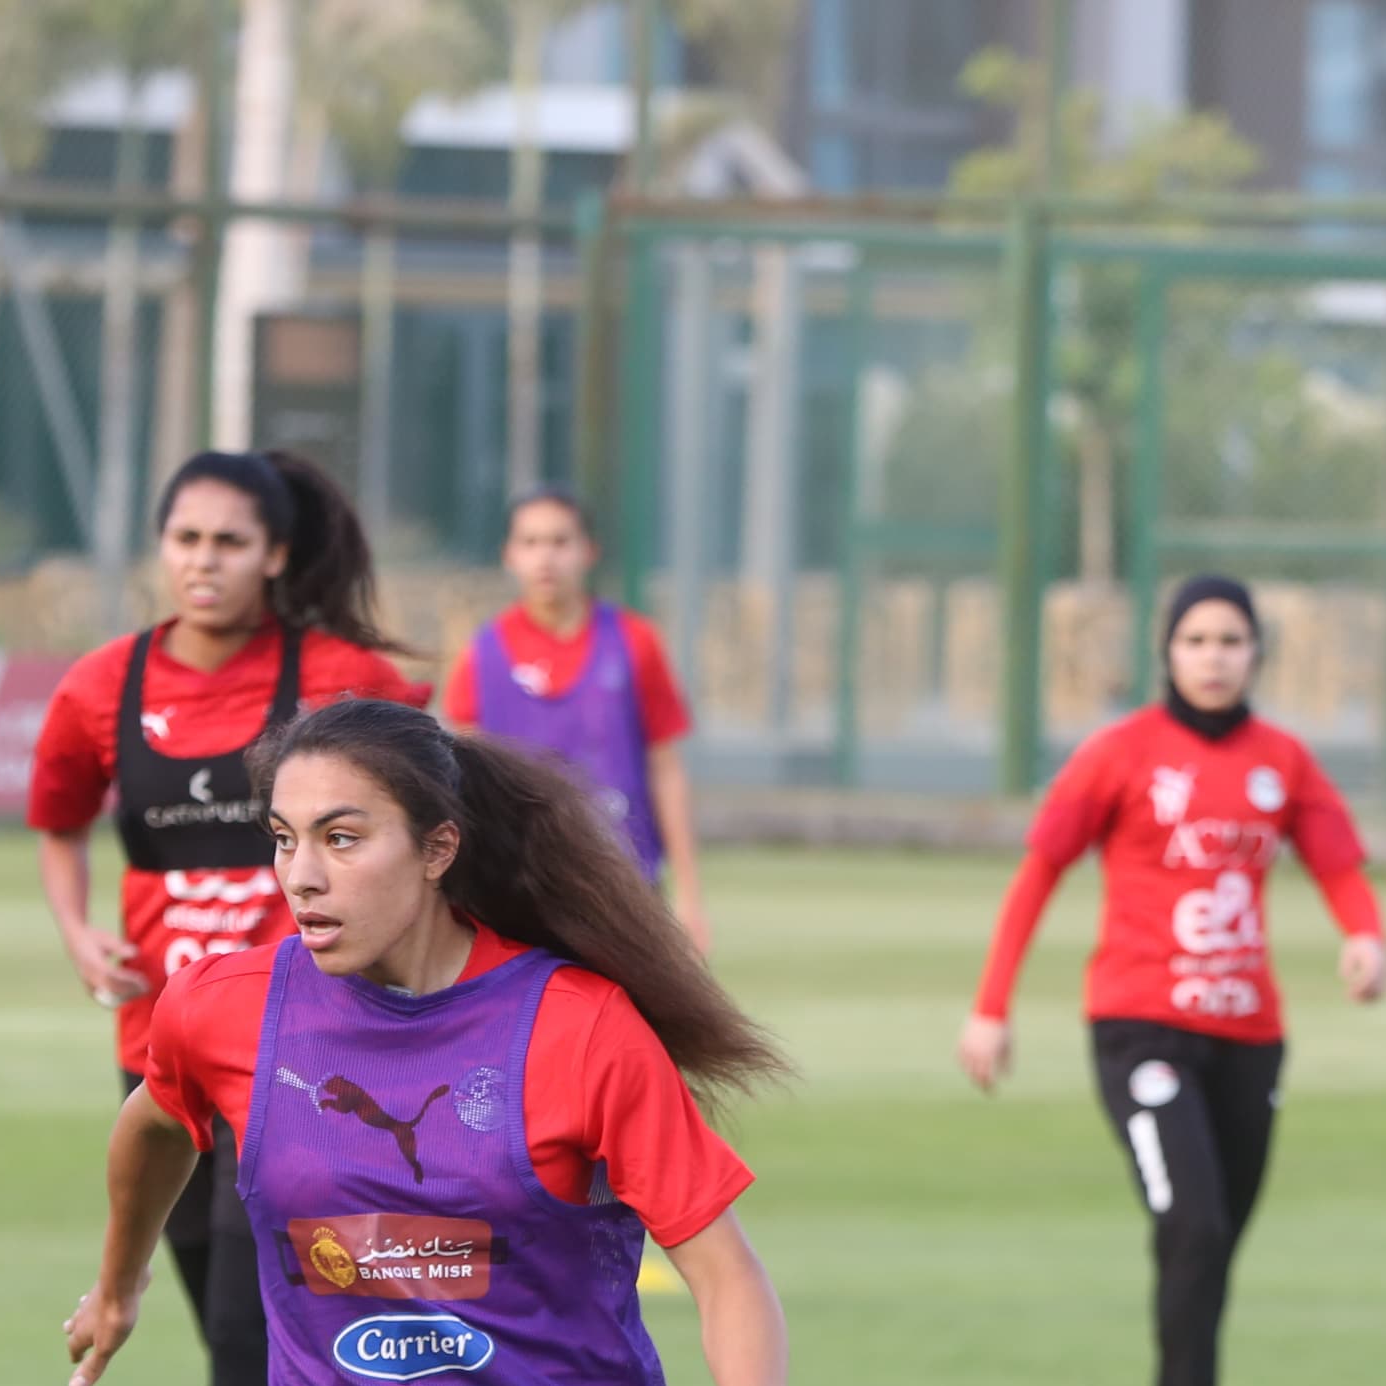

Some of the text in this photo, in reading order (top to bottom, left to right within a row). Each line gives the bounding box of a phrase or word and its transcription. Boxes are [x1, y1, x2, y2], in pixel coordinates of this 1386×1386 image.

[358, 1263, 473, 1280] BANQUE MISR
[356, 1328, 473, 1361] Carrier
